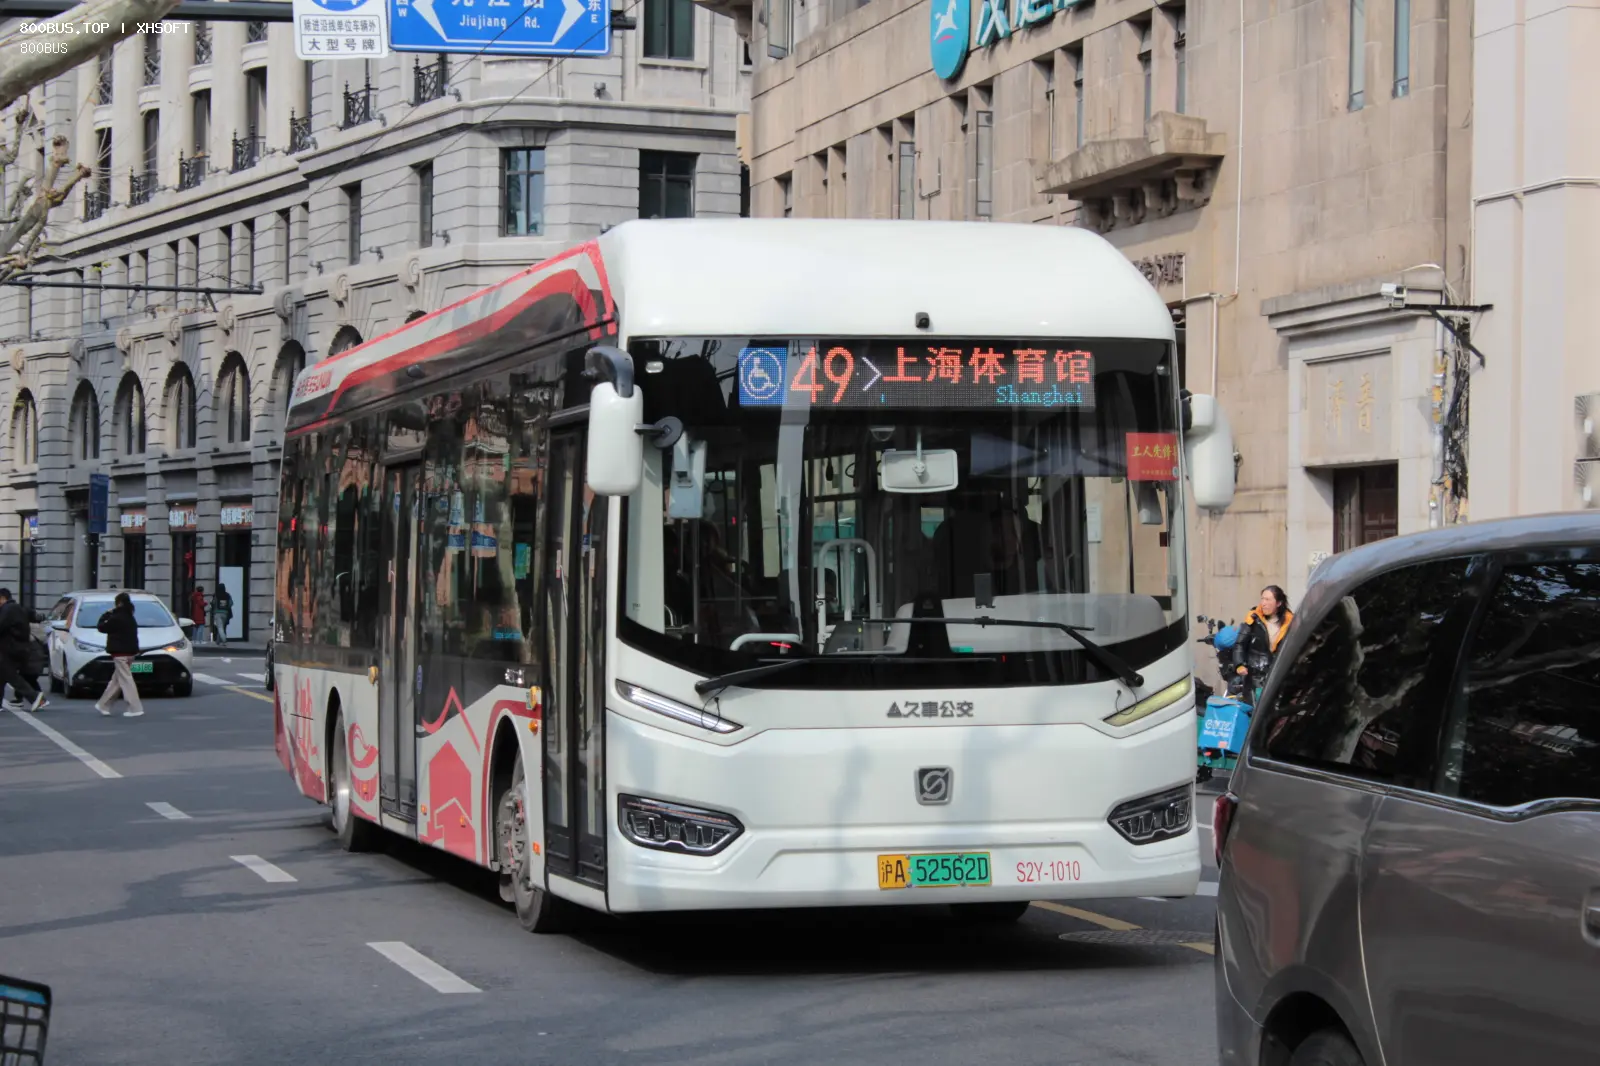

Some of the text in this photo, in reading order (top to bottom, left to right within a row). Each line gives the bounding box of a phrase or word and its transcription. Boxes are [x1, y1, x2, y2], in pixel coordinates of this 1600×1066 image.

[398, 8, 407, 17] W
[459, 15, 541, 30] Jiujiang Rd.
[590, 15, 598, 24] E
[308, 38, 376, 52] 大型号牌
[790, 346, 855, 404] 49
[882, 346, 1094, 385] 上海体育馆
[996, 384, 1083, 407] Shanghai
[915, 856, 989, 884] 52562D
[1016, 860, 1081, 883] S2Y-1010
